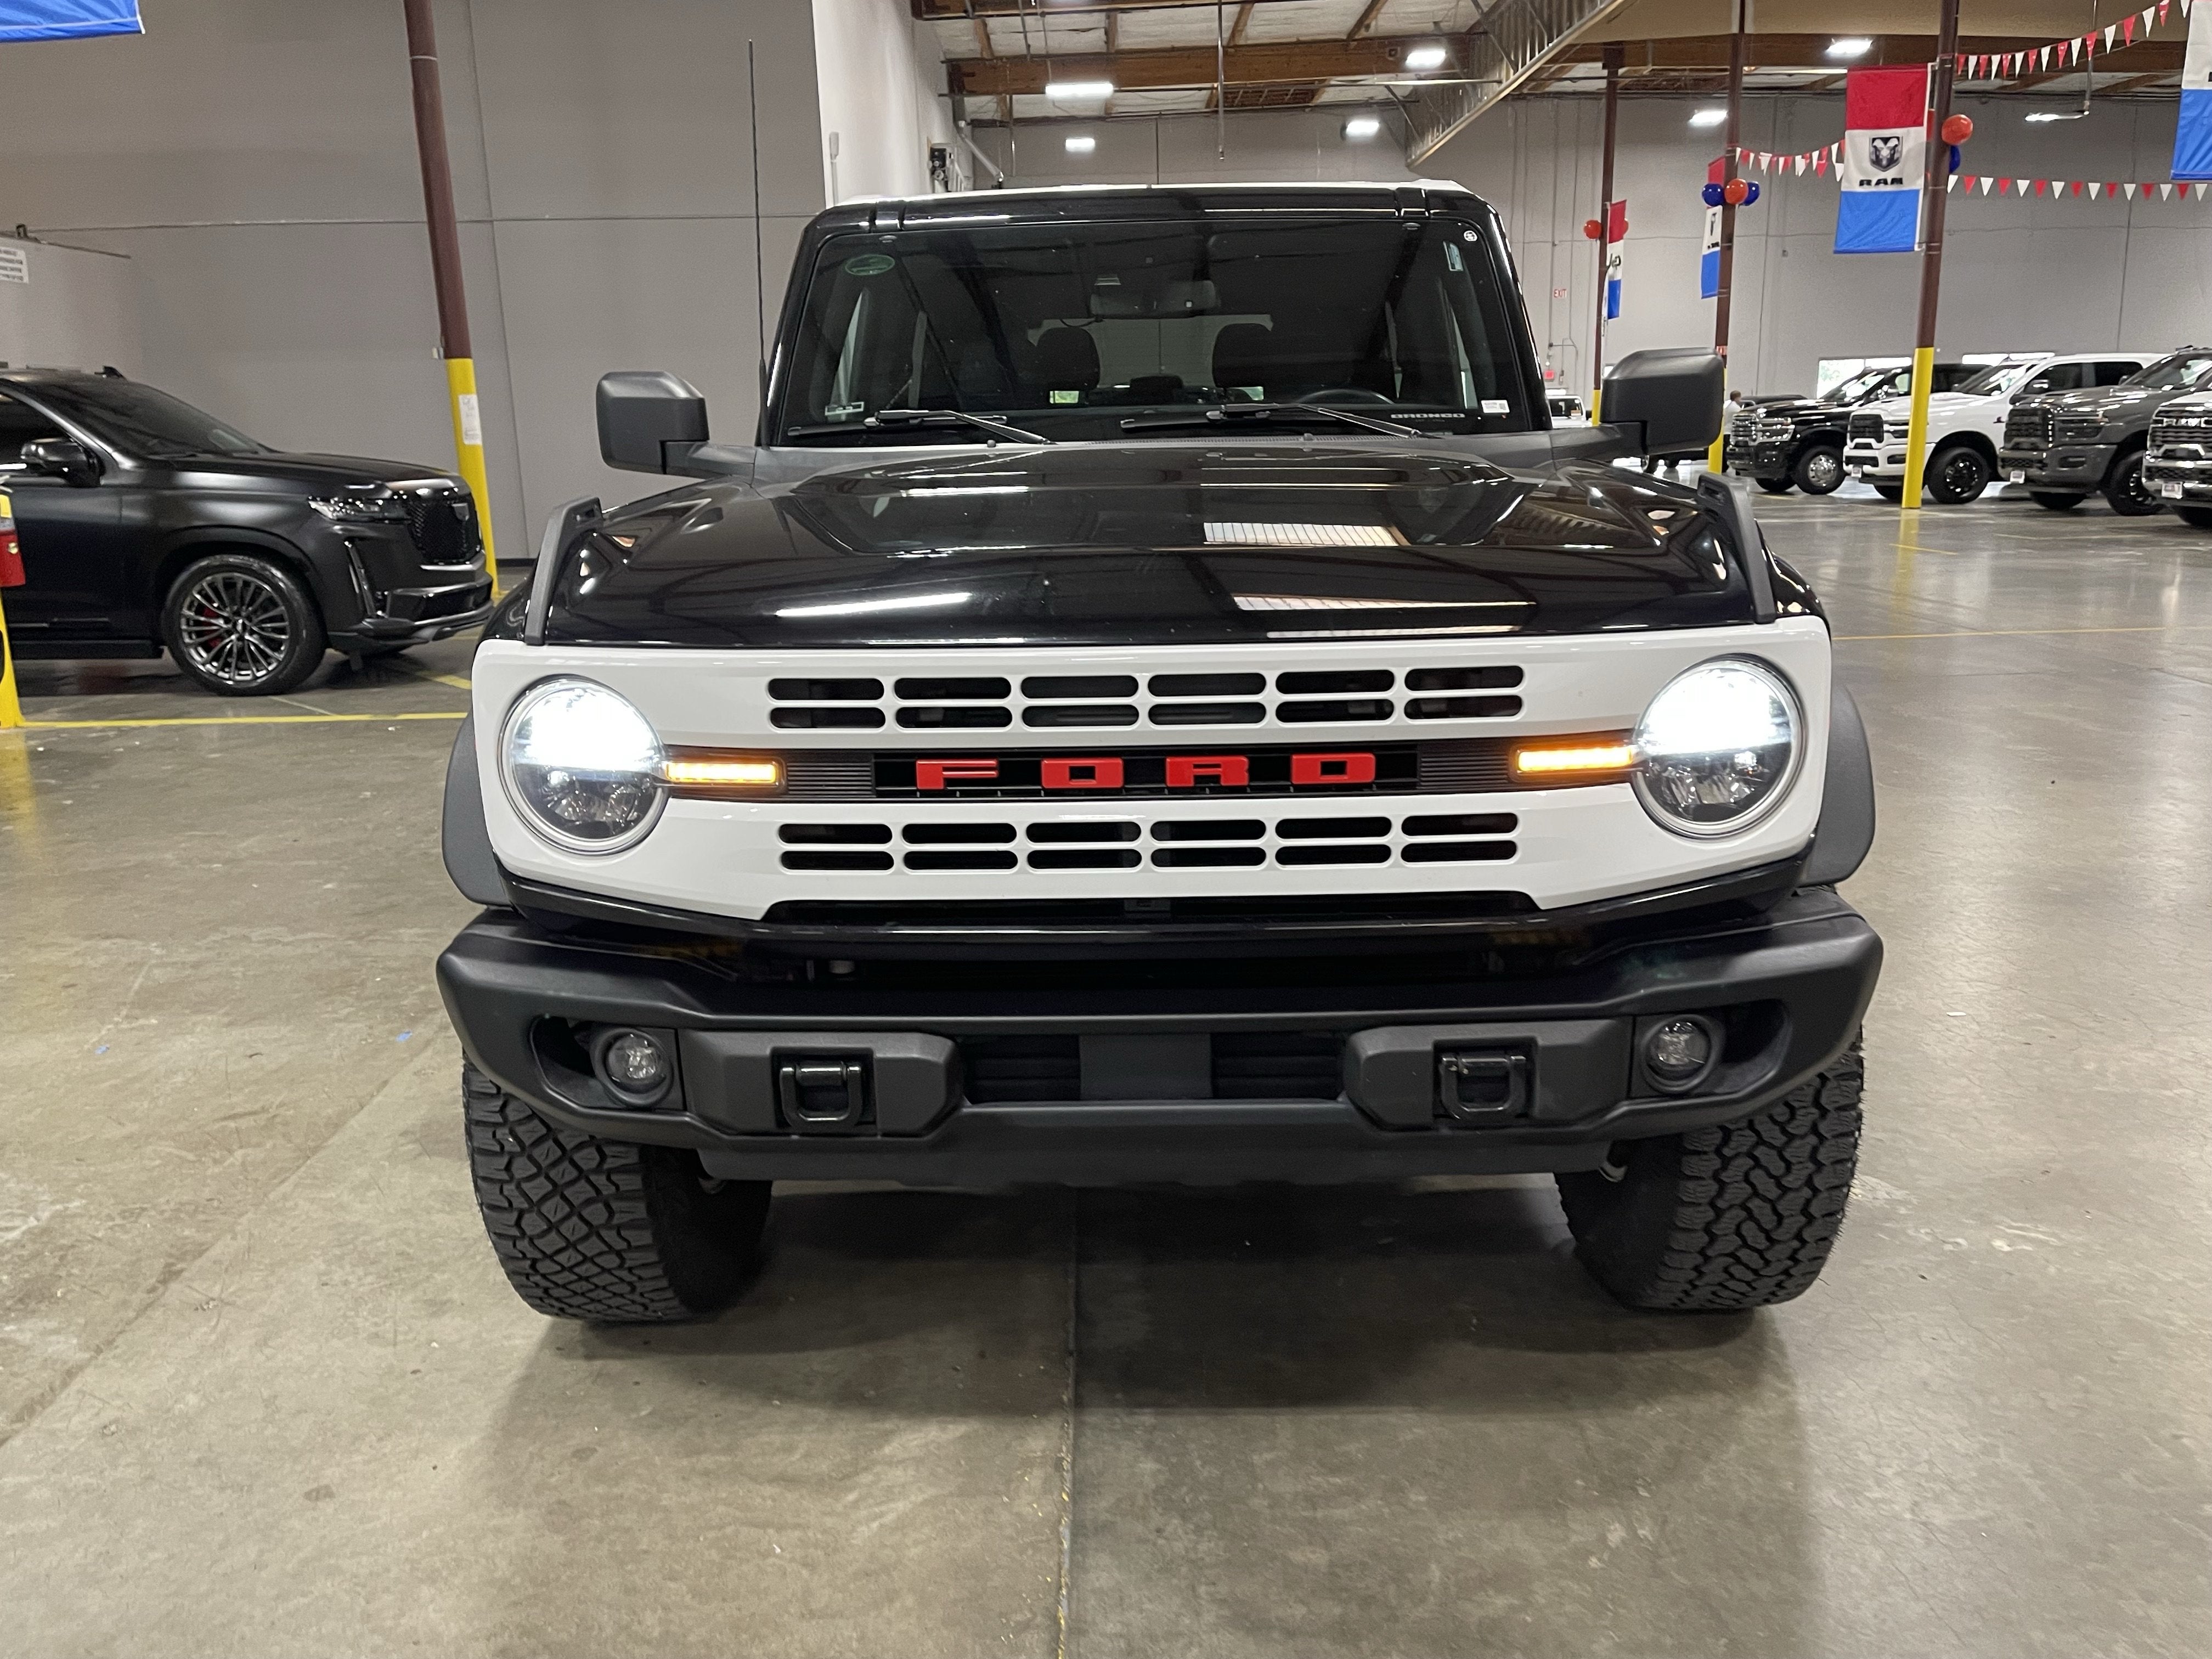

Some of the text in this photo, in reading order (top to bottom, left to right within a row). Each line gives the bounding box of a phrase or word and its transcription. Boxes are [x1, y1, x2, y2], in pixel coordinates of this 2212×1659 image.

[1859, 178, 1903, 187] RAM
[1553, 289, 1567, 298] EXIT
[916, 753, 1376, 790] FORD
